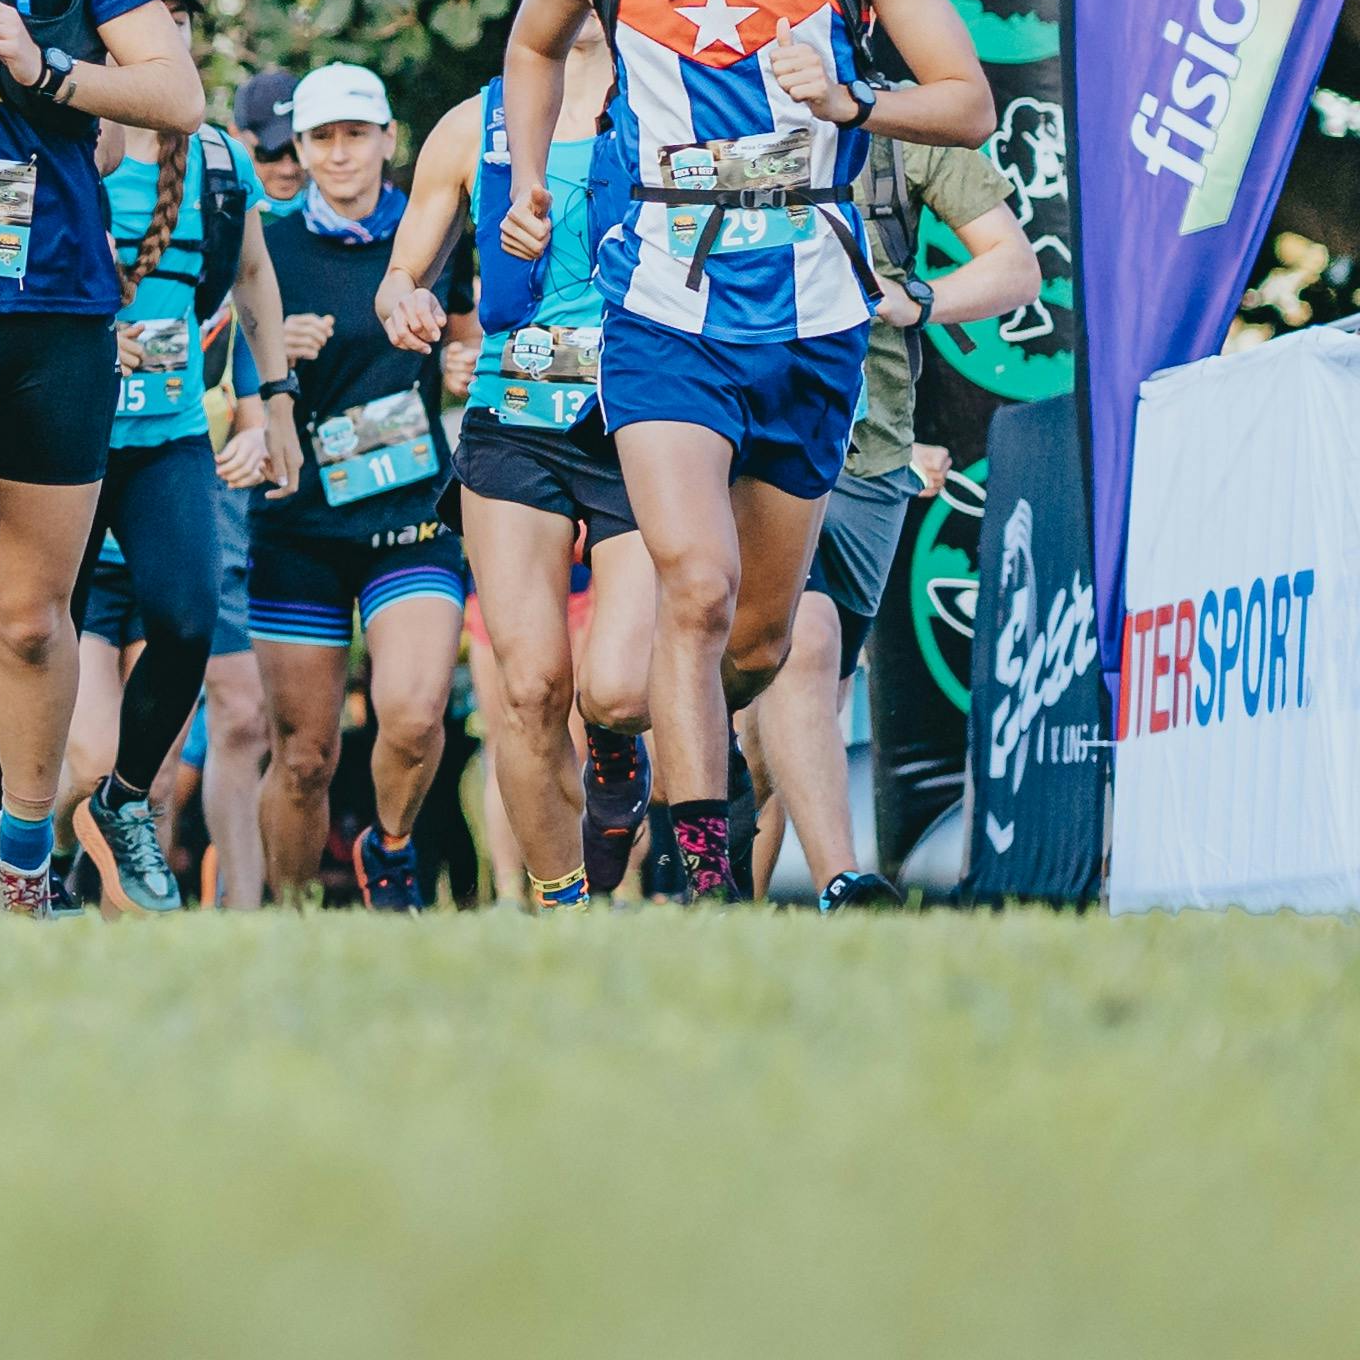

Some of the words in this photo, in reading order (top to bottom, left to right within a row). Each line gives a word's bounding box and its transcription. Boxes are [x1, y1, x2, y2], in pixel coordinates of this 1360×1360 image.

[721, 207, 767, 247] 29
[551, 389, 586, 423] 13
[368, 453, 397, 487] 11
[1118, 569, 1314, 741] TERSPORT
